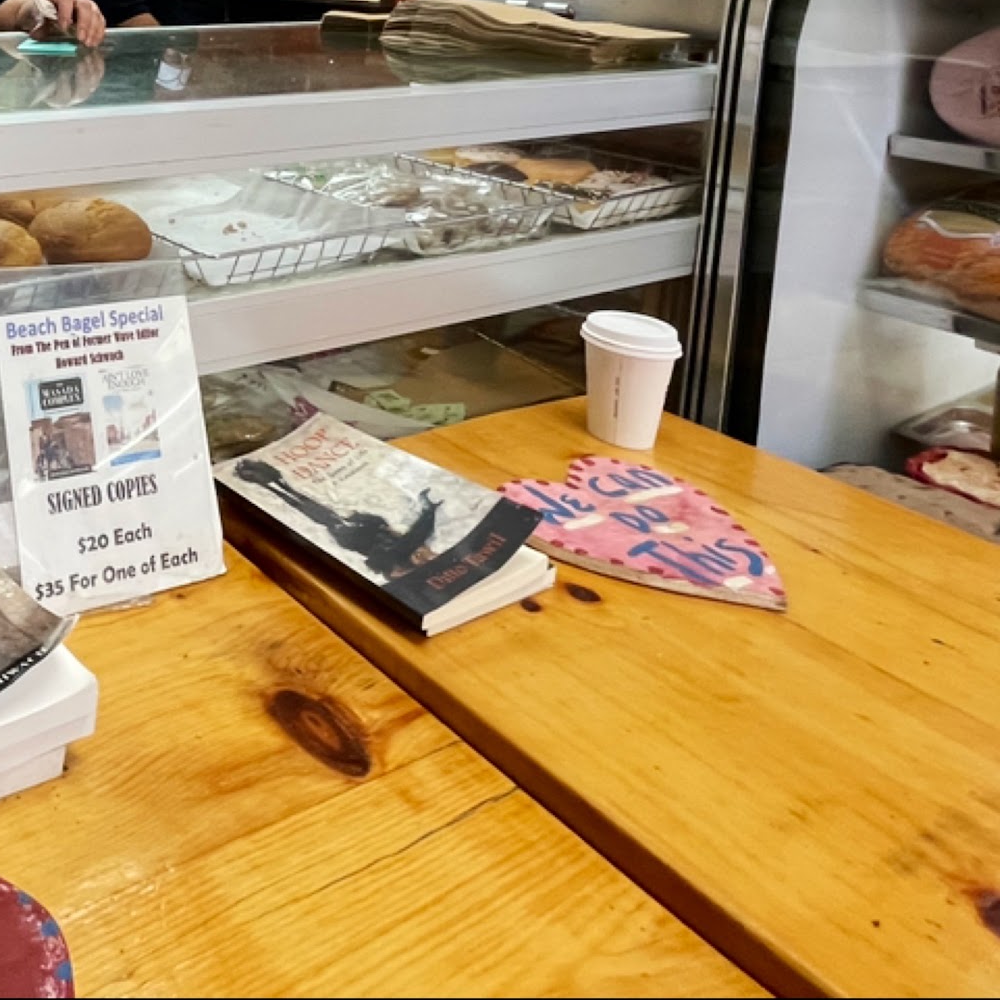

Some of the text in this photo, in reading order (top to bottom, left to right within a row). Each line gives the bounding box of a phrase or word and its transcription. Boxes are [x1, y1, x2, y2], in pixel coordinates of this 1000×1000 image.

[5, 304, 164, 339] Beach Bagel Special
[10, 344, 34, 356] From
[35, 340, 51, 353] The
[54, 338, 70, 351] Pen
[55, 354, 88, 369] Howard
[273, 427, 328, 465] HOOP
[47, 474, 158, 515] SIGNED COPIES
[608, 504, 671, 534] DO
[78, 523, 153, 554] $20 Each
[34, 548, 199, 601] $35 For One of Each
